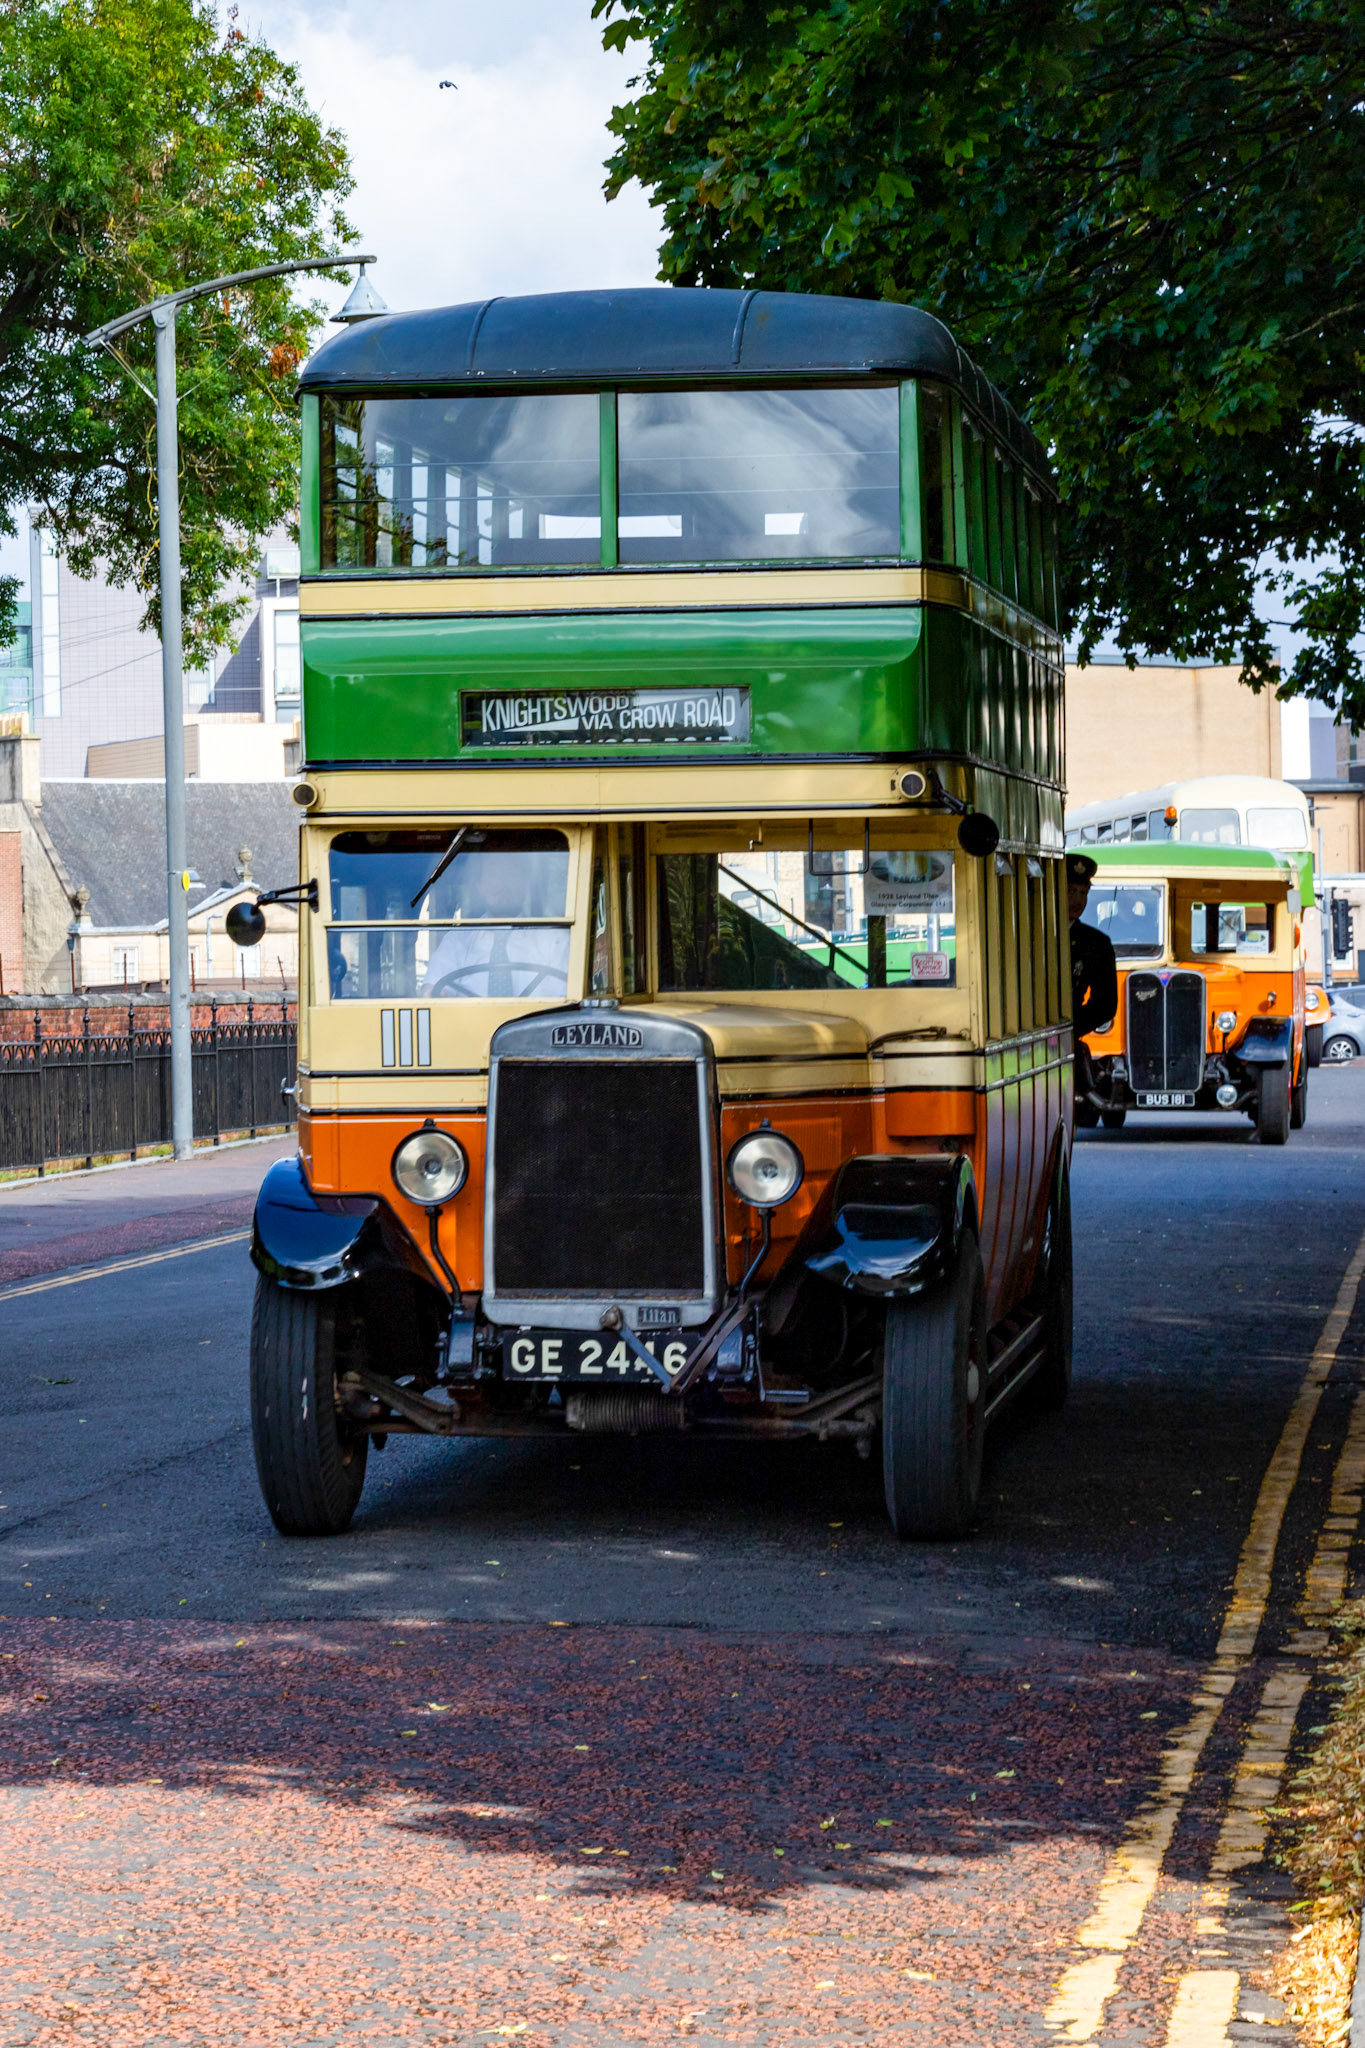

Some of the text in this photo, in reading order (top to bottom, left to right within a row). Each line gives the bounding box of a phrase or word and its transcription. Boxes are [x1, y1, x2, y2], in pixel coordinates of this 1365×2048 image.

[482, 695, 629, 732] KNIGHTSWOOD
[578, 695, 736, 730] VIA CROW ROAD
[554, 1025, 641, 1046] LEYLAND
[1146, 1094, 1186, 1105] BUS 181
[510, 1338, 563, 1373] GE
